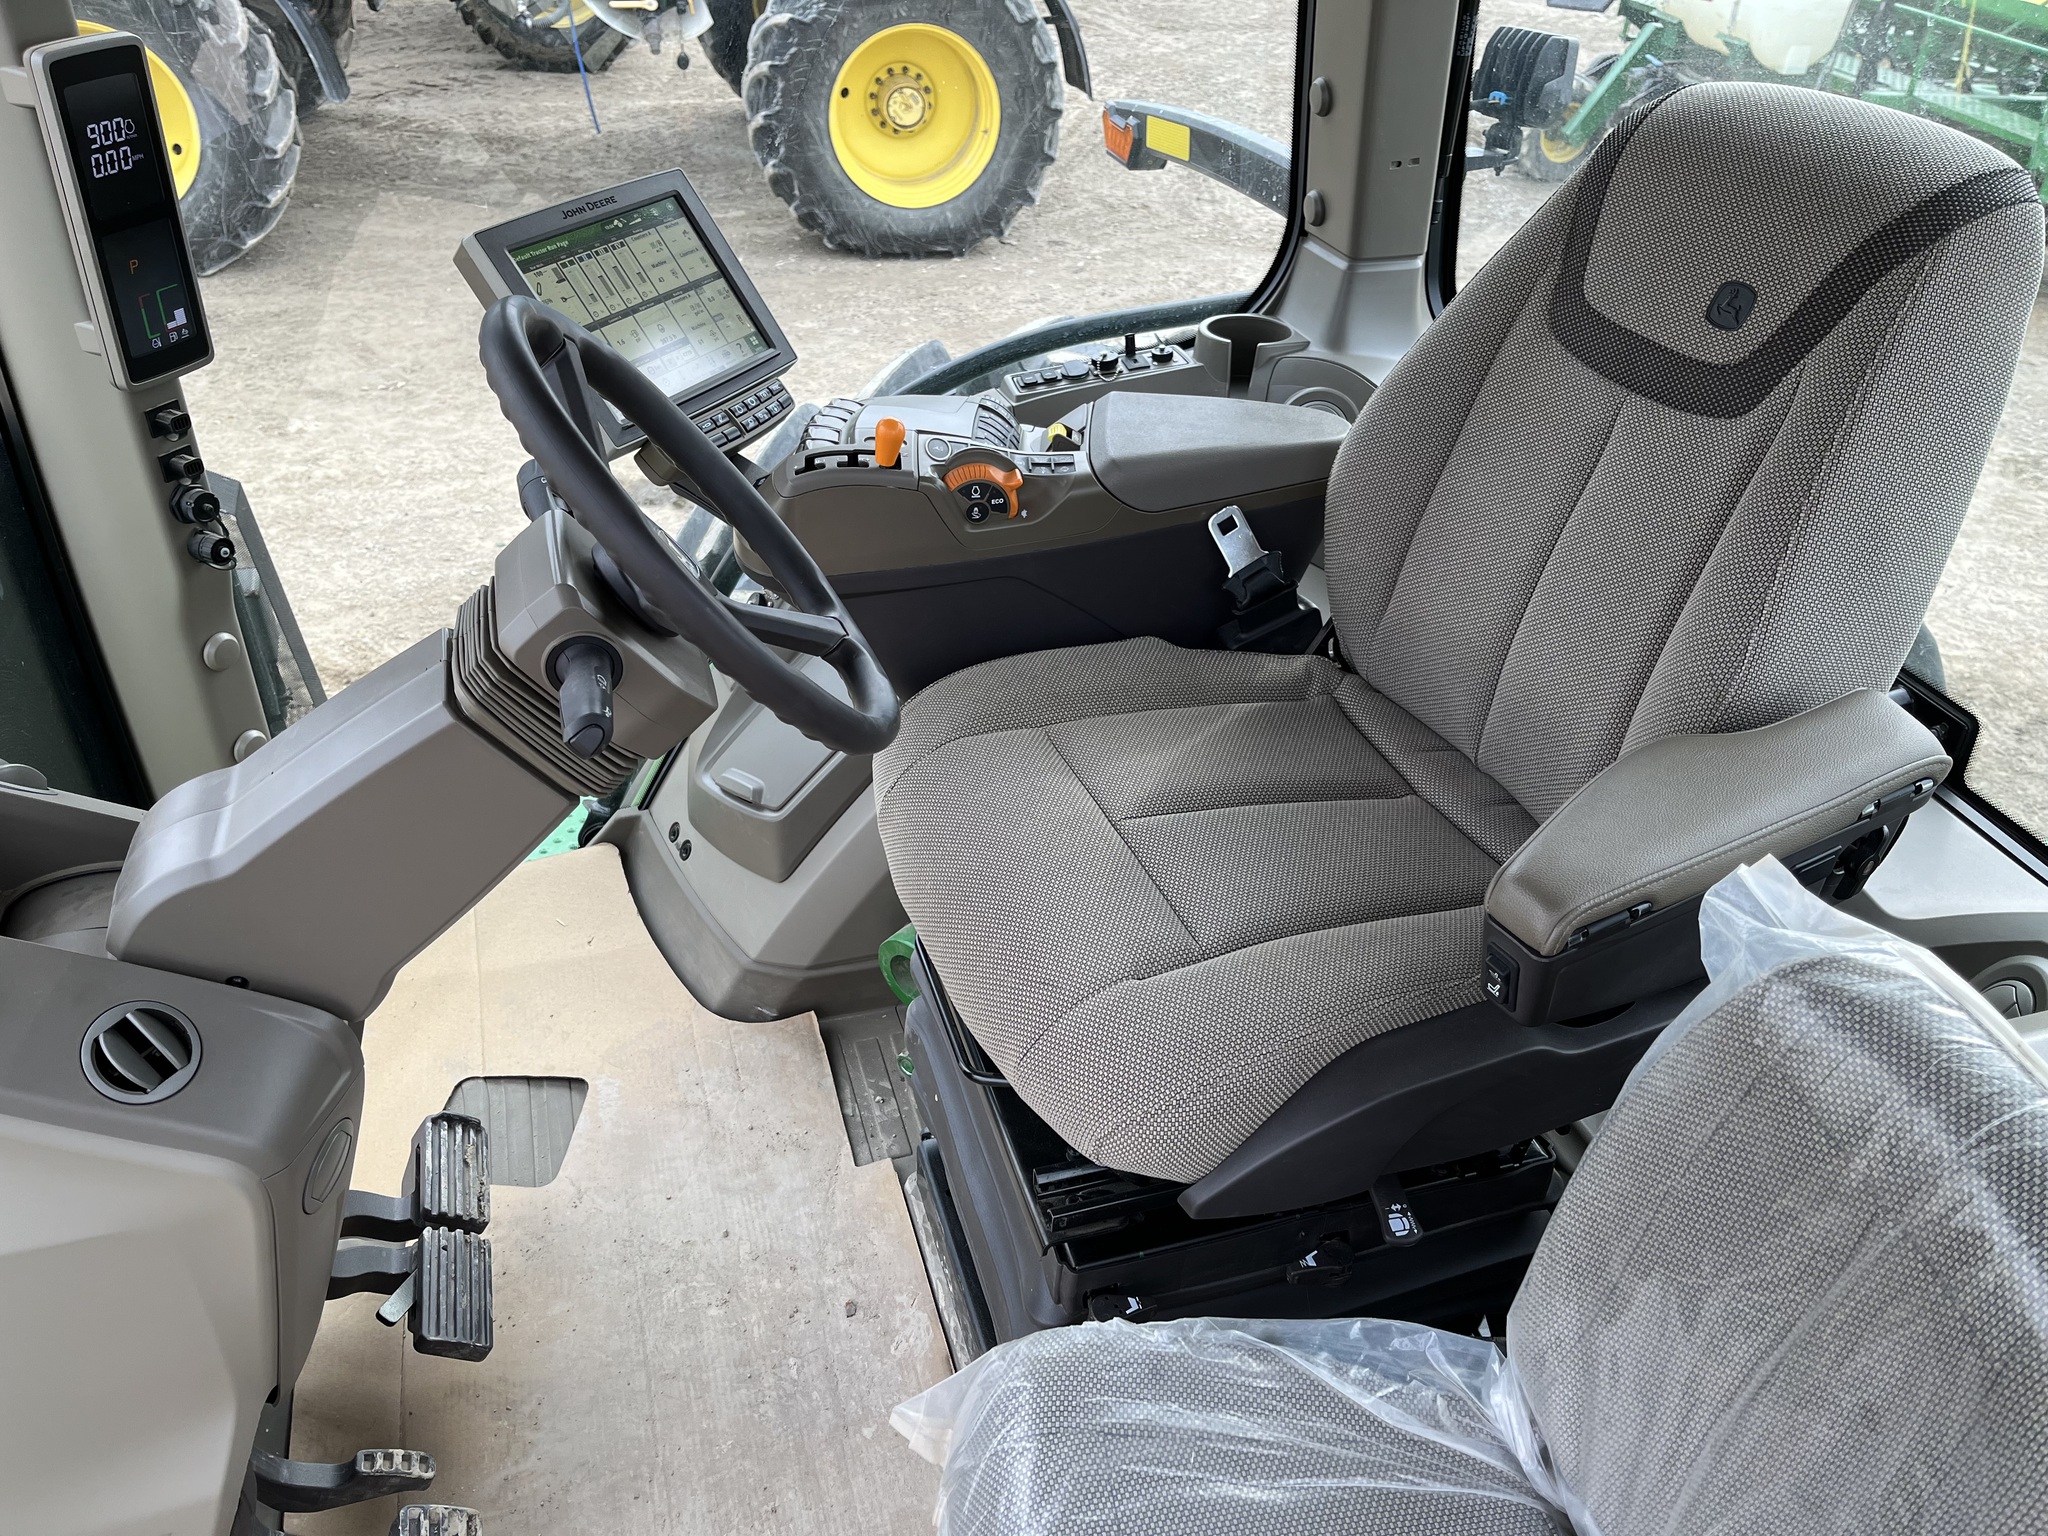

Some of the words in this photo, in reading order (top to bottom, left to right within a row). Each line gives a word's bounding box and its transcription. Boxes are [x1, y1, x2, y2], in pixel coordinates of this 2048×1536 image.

[86, 117, 126, 149] 900
[91, 146, 132, 178] 0.00
[132, 153, 144, 161] MPH
[562, 206, 588, 220] JOHN
[585, 196, 618, 212] DEERE
[530, 247, 547, 256] Tractor
[557, 240, 569, 248] Page
[130, 260, 139, 274] P
[651, 260, 666, 268] Machine
